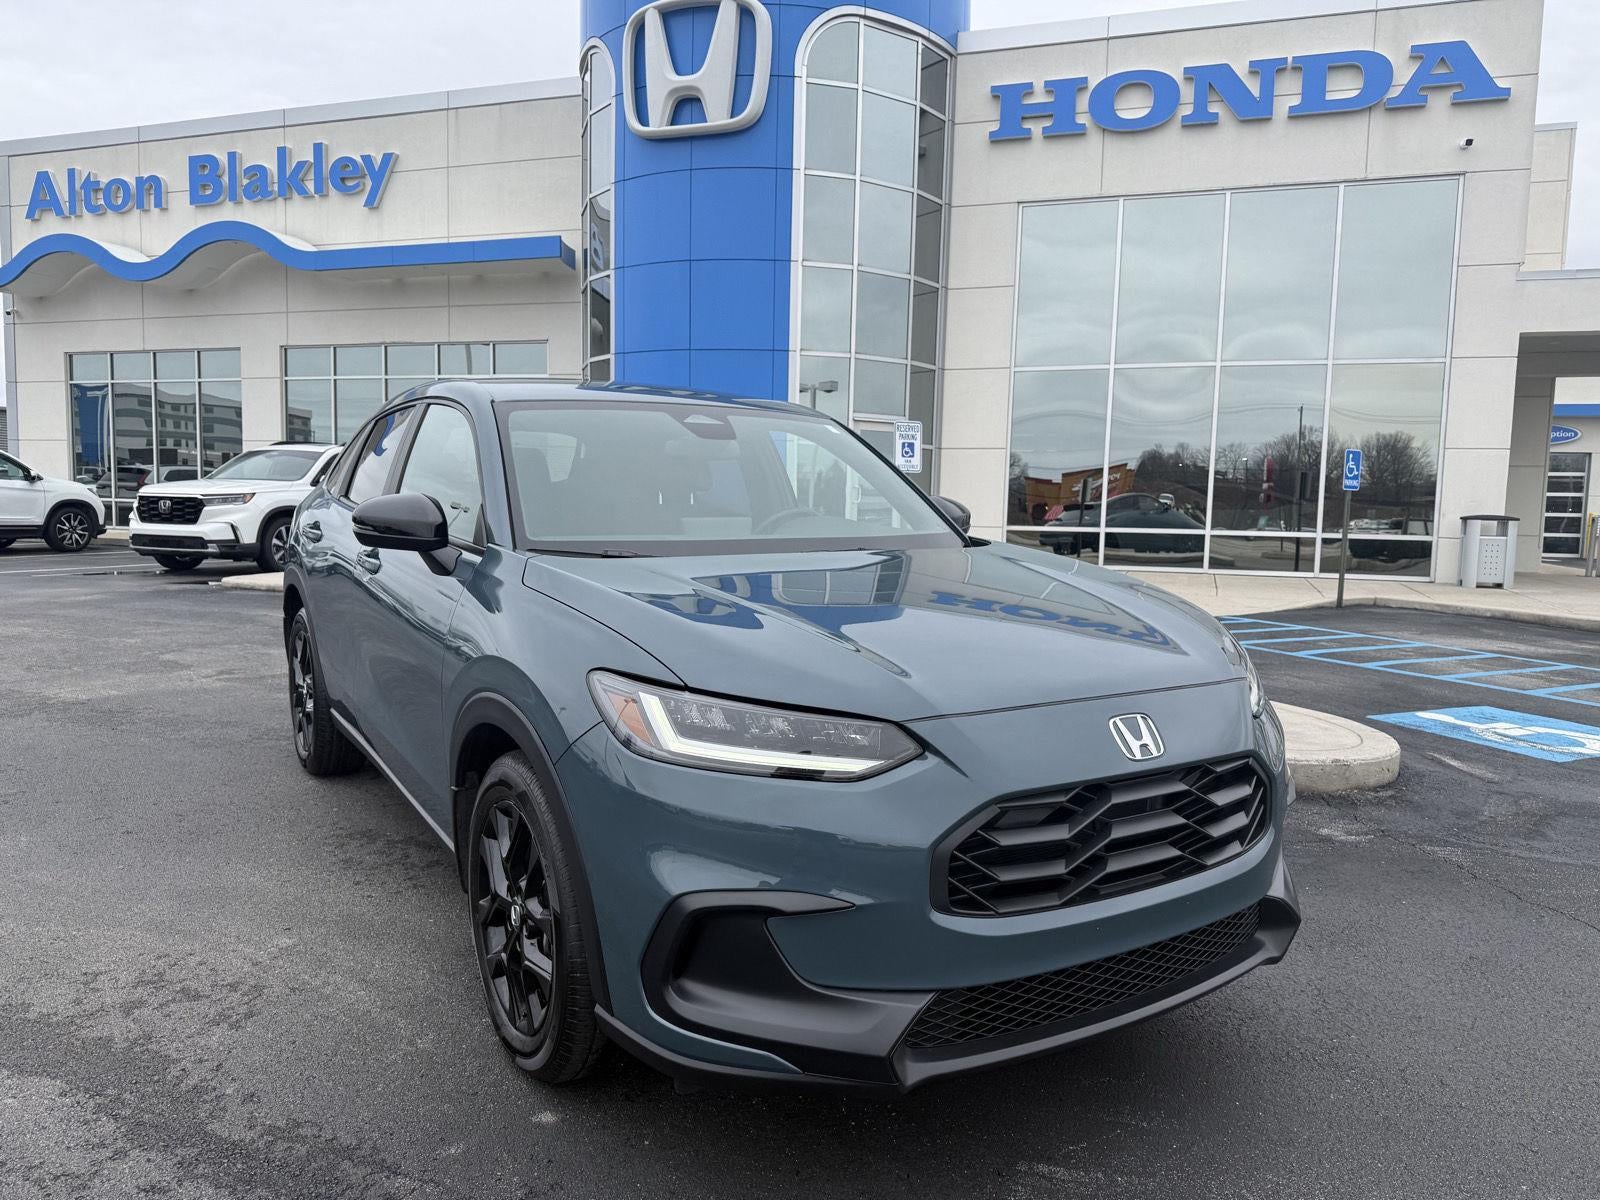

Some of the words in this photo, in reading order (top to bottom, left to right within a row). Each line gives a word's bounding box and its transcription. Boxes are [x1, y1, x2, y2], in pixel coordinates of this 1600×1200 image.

[988, 40, 1511, 141] HONDA
[25, 167, 167, 221] Alton
[188, 142, 398, 209] Blakley
[896, 424, 920, 433] RESERVED
[899, 433, 918, 441] PARKING
